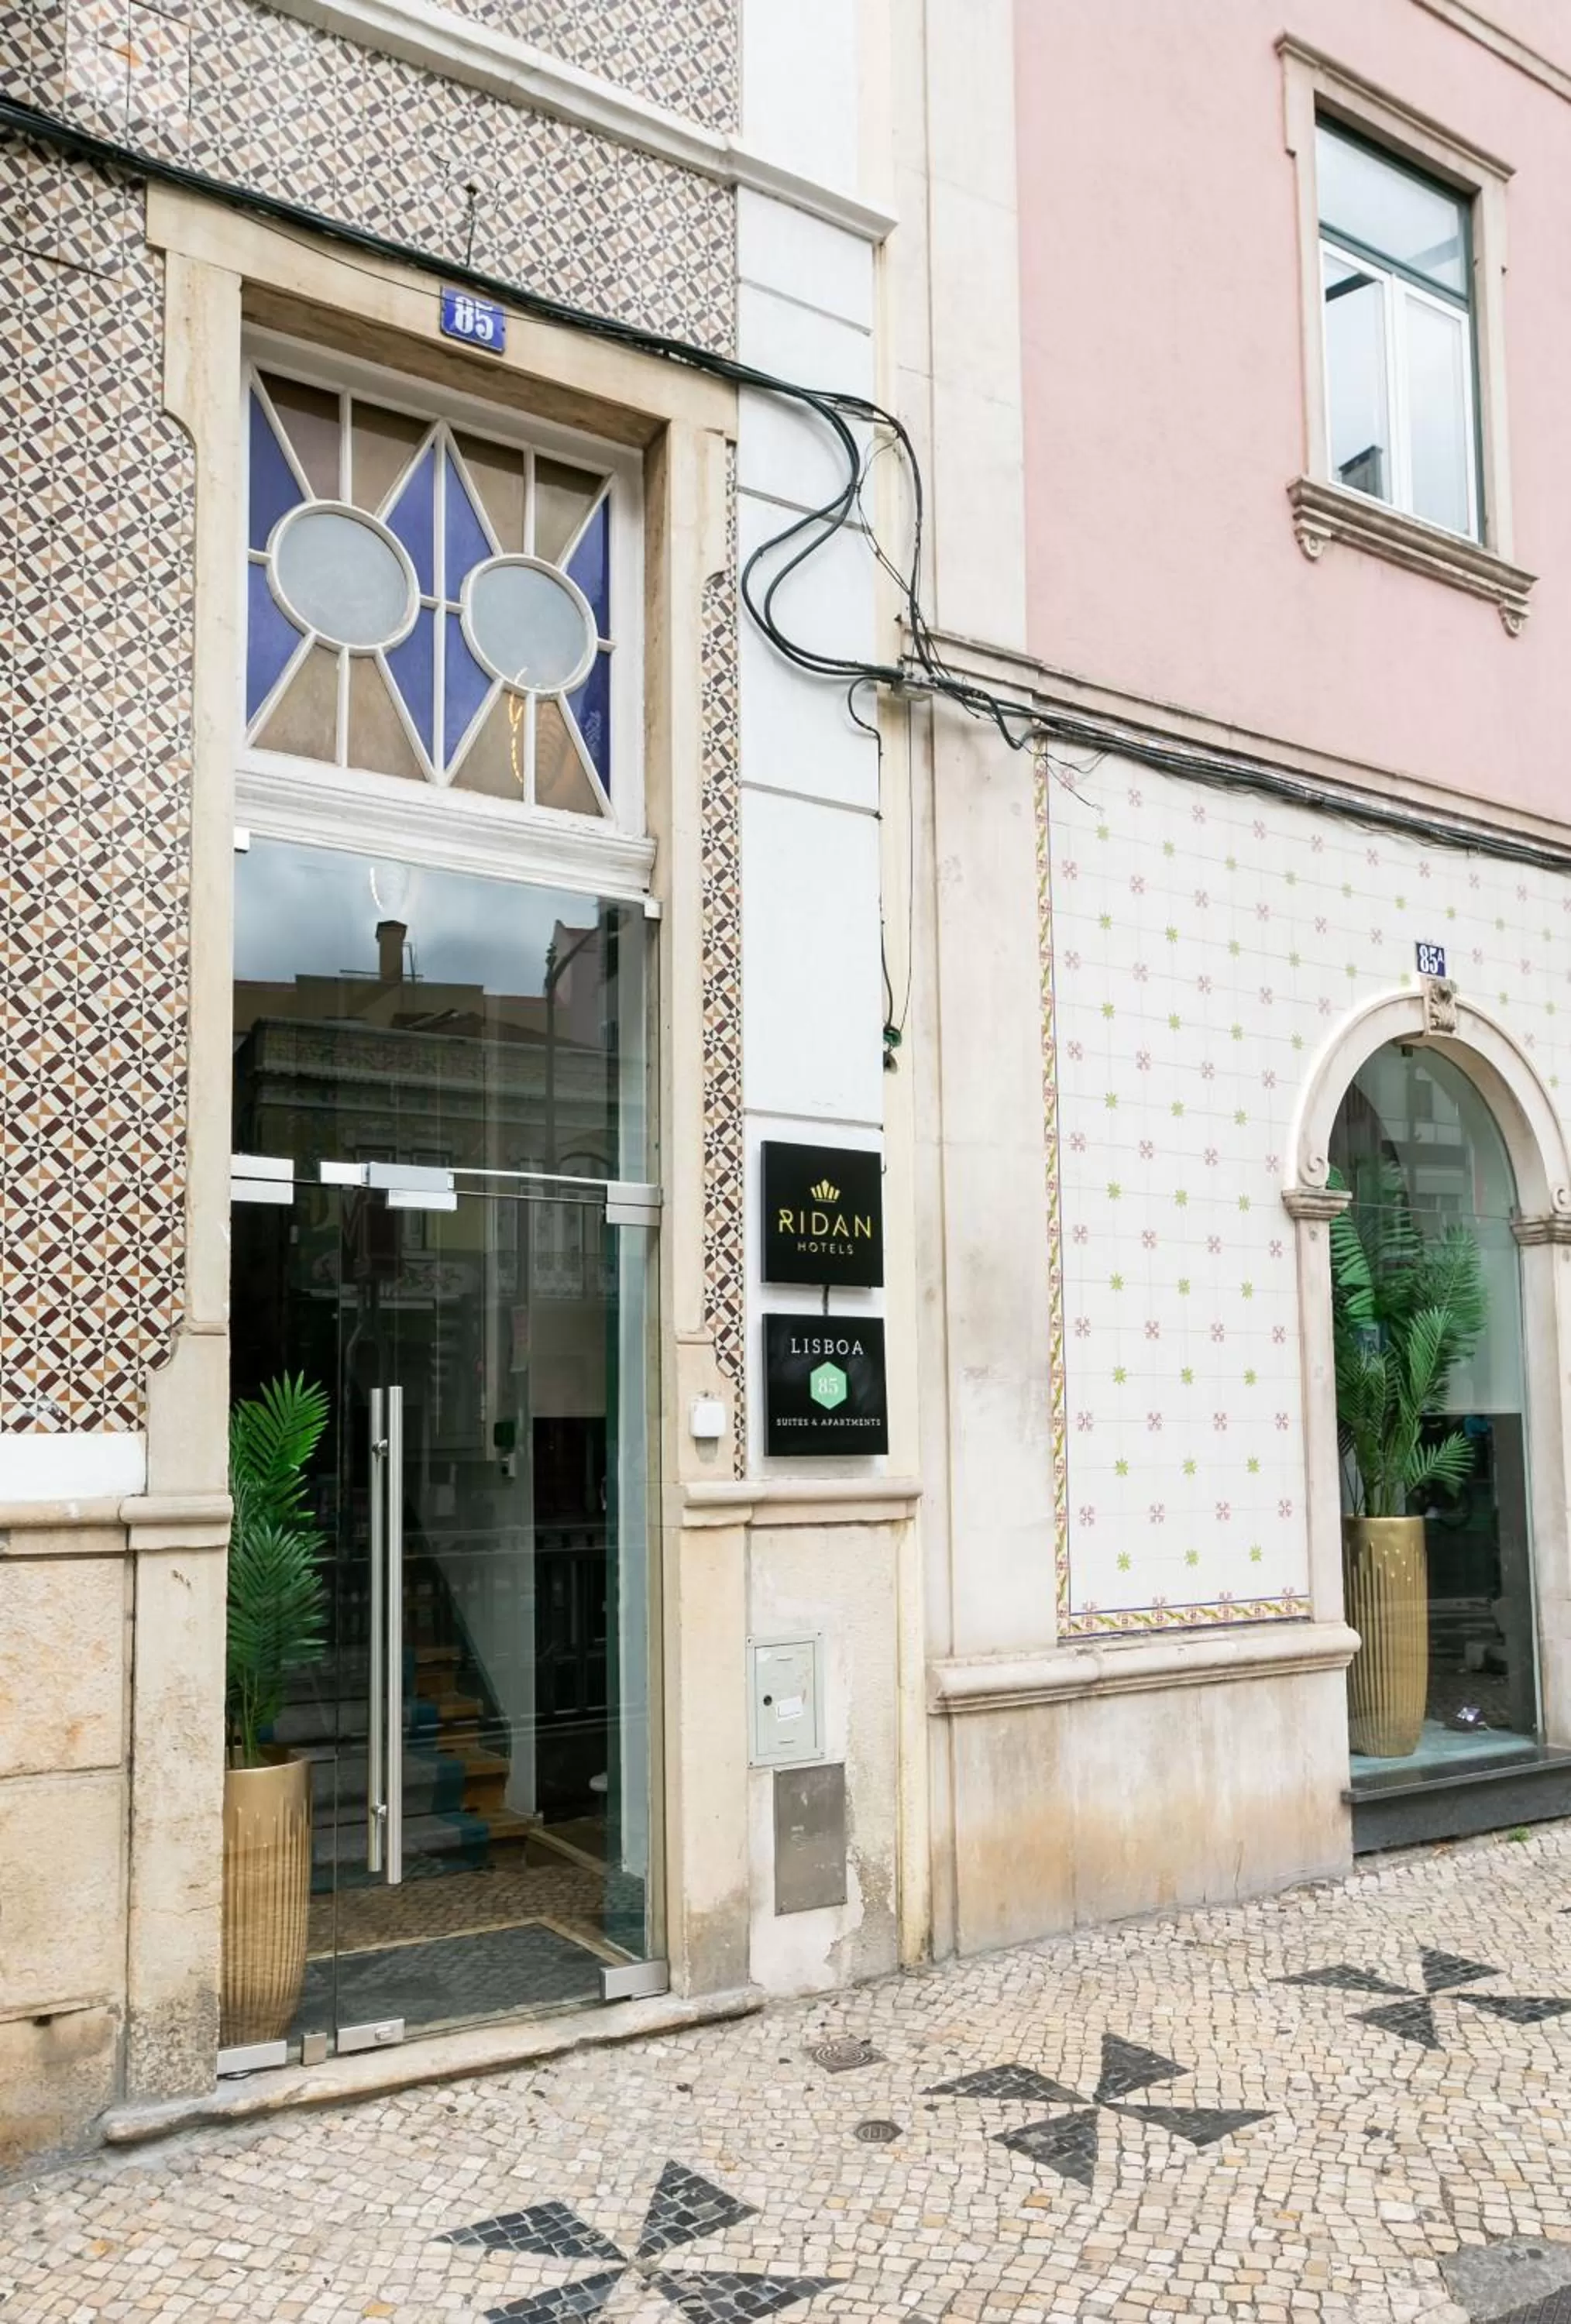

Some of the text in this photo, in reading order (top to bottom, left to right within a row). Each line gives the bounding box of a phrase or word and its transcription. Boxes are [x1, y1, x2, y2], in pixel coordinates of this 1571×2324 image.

[455, 295, 494, 341] 85
[778, 1208, 872, 1239] RIDAN
[797, 1241, 854, 1255] HOTELS
[790, 1337, 865, 1356] LISBOA
[817, 1377, 839, 1395] 85
[776, 1418, 809, 1427] SUITES
[820, 1418, 882, 1427] APARTMENTS
